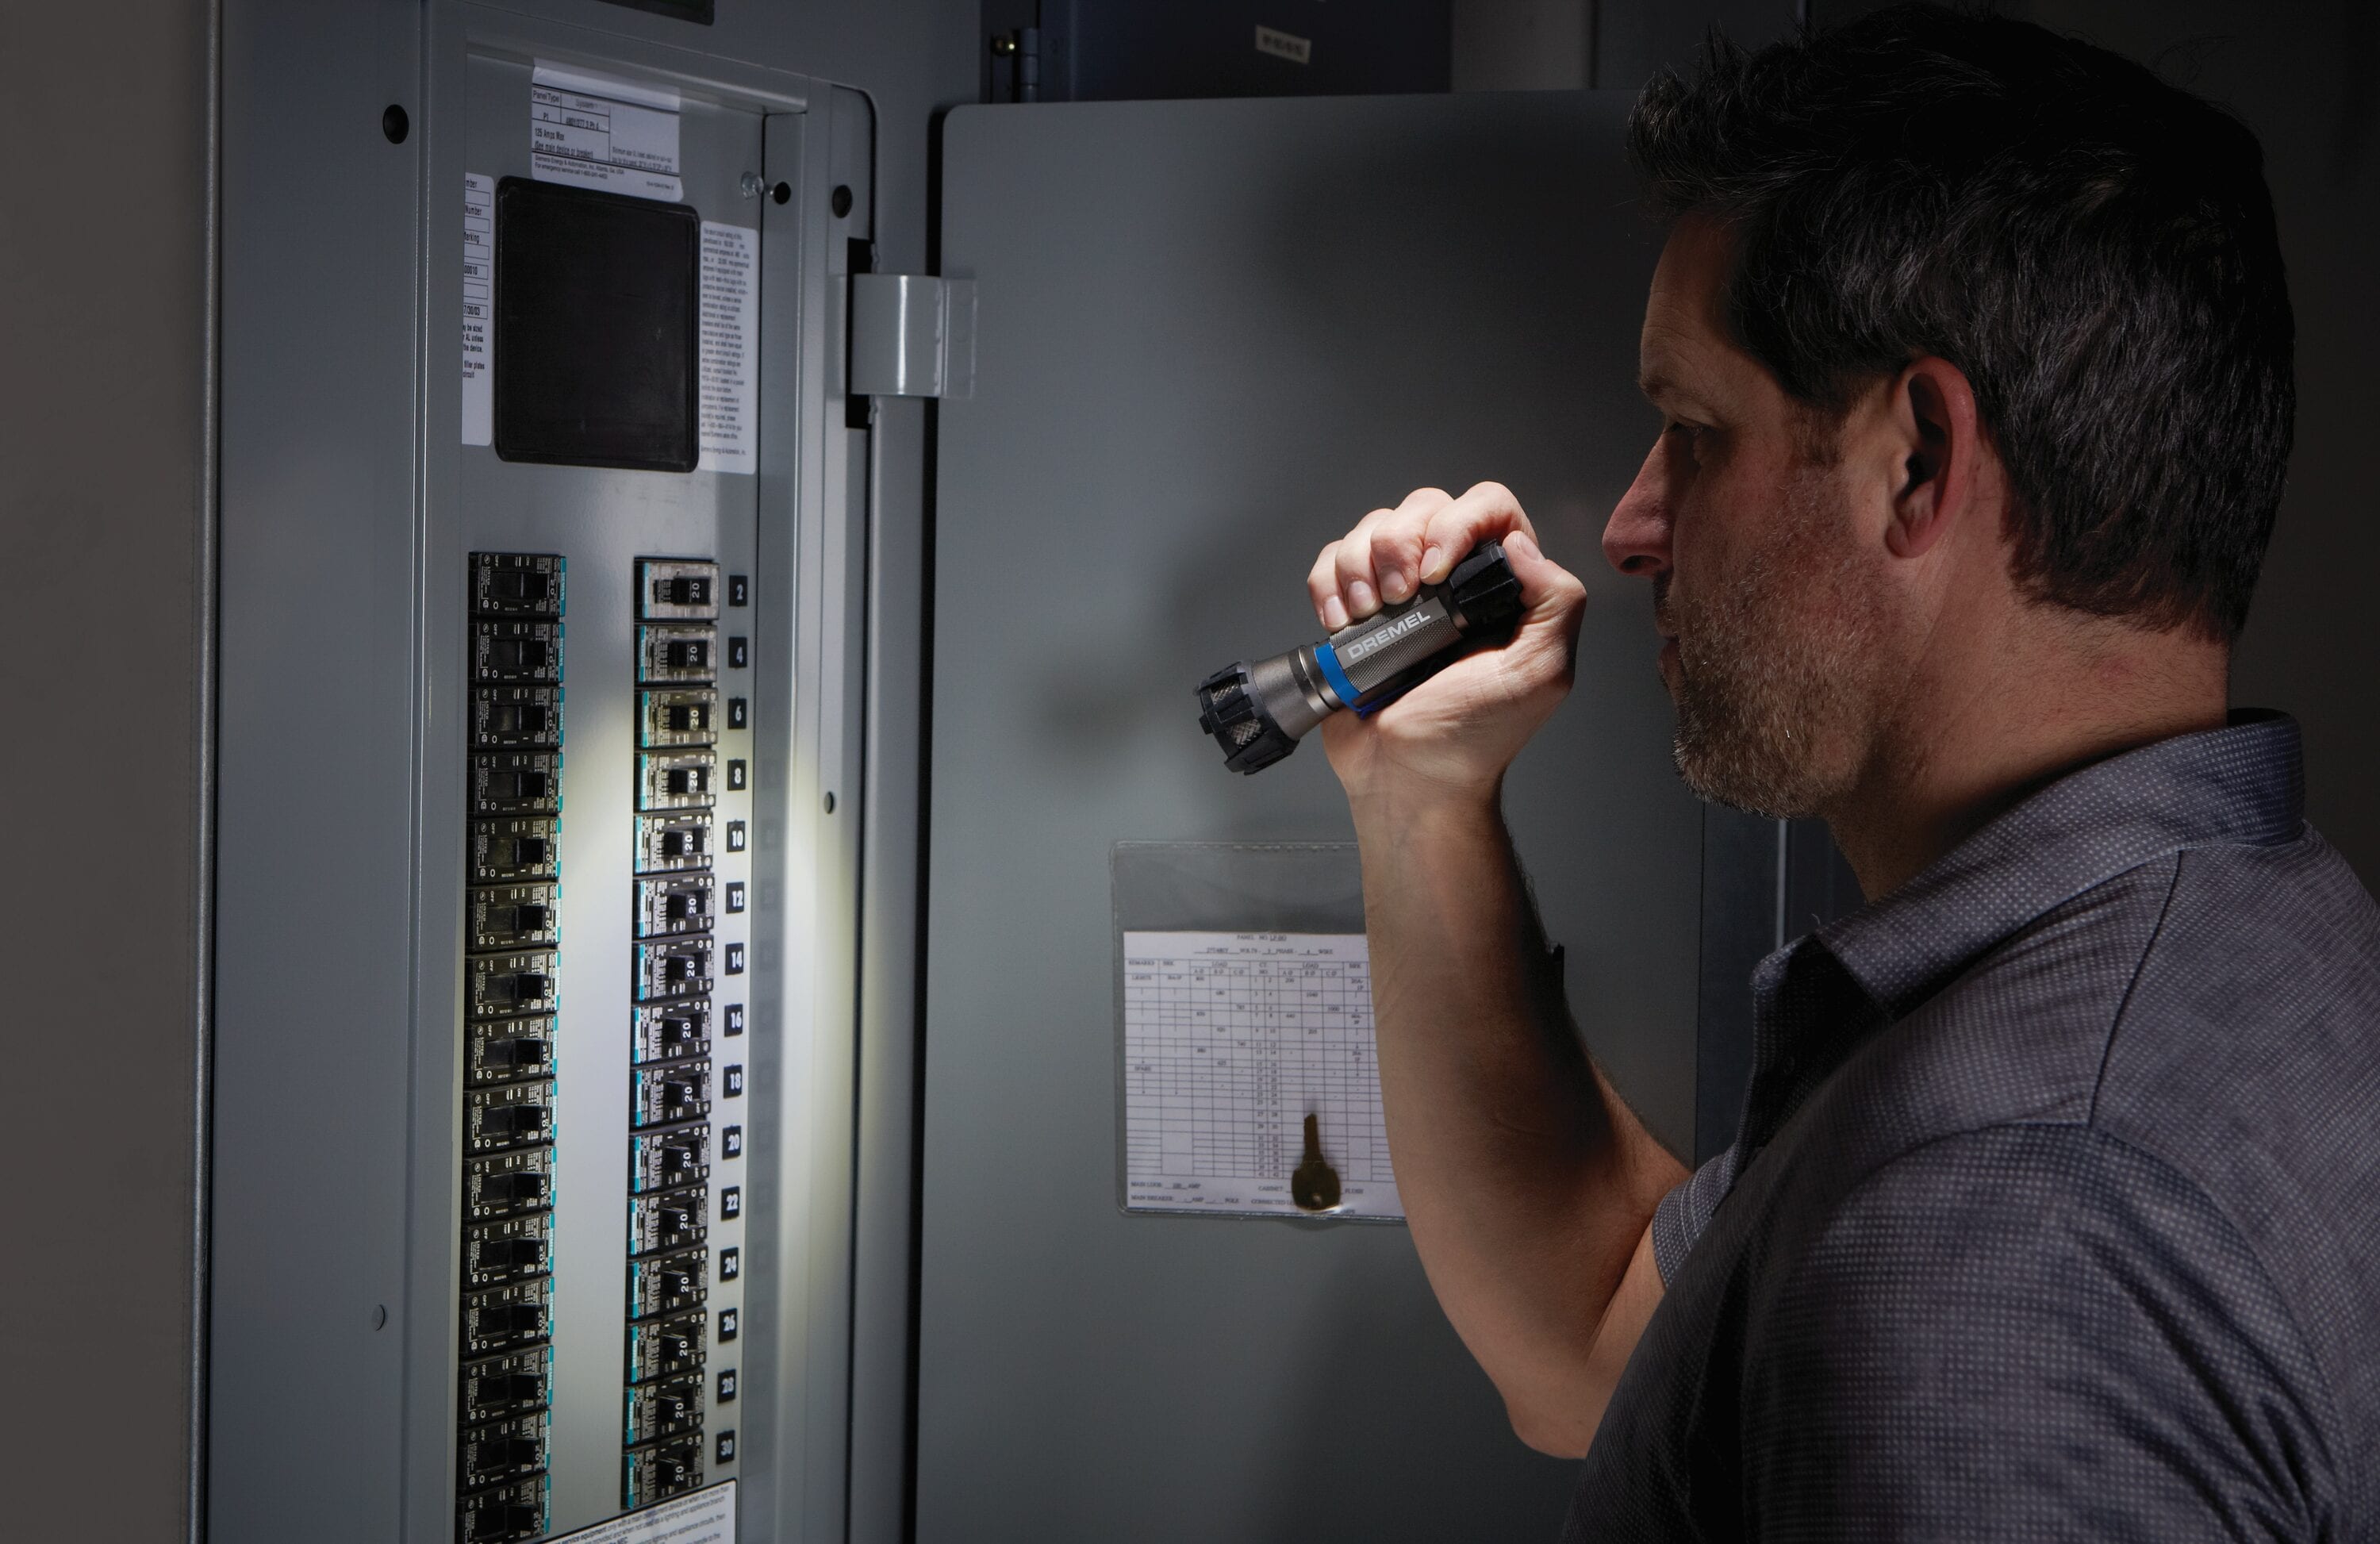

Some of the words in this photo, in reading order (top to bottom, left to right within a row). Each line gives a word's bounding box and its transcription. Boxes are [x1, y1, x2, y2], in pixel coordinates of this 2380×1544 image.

[533, 90, 547, 100] Panel
[547, 93, 559, 102] Type
[543, 129, 555, 140] Amps
[557, 144, 570, 155] device
[551, 578, 555, 595] 20
[692, 582, 700, 598] 20
[736, 584, 743, 600] 2
[1347, 611, 1431, 659] DREMEL
[549, 647, 554, 663] 20
[690, 647, 697, 662] 20
[736, 648, 743, 663] 4
[548, 710, 553, 727] 20
[691, 709, 699, 725] 20
[735, 707, 742, 721] 6
[690, 770, 697, 787] 20
[734, 768, 741, 784] 8
[548, 779, 552, 795] 20
[685, 834, 693, 850] 20
[731, 831, 743, 847] 10
[547, 845, 551, 861] 20
[689, 898, 697, 913] 20
[731, 892, 743, 907] 12
[546, 912, 550, 927] 20
[731, 952, 742, 967] 14
[687, 961, 695, 977] 20
[544, 981, 549, 996] 20
[731, 1012, 742, 1028] 16
[683, 1022, 691, 1039] 20
[543, 1046, 547, 1062] 20
[731, 1074, 741, 1089] 18
[685, 1086, 693, 1102] 20
[542, 1111, 547, 1127] 20
[728, 1135, 740, 1150] 20
[683, 1152, 691, 1168] 20
[540, 1179, 545, 1195] 20
[727, 1195, 738, 1211] 22
[680, 1213, 688, 1229] 20
[539, 1245, 543, 1262] 20
[724, 1257, 736, 1273] 24
[681, 1277, 689, 1292] 20
[538, 1311, 543, 1327] 20
[724, 1316, 735, 1331] 26
[679, 1341, 688, 1357] 20
[537, 1381, 542, 1396] 20
[722, 1377, 735, 1393] 28
[675, 1403, 684, 1418] 20
[535, 1445, 540, 1461] 20
[720, 1439, 733, 1455] 30
[676, 1466, 684, 1481] 20
[533, 1511, 538, 1527] 20
[581, 1527, 606, 1540] equipment
